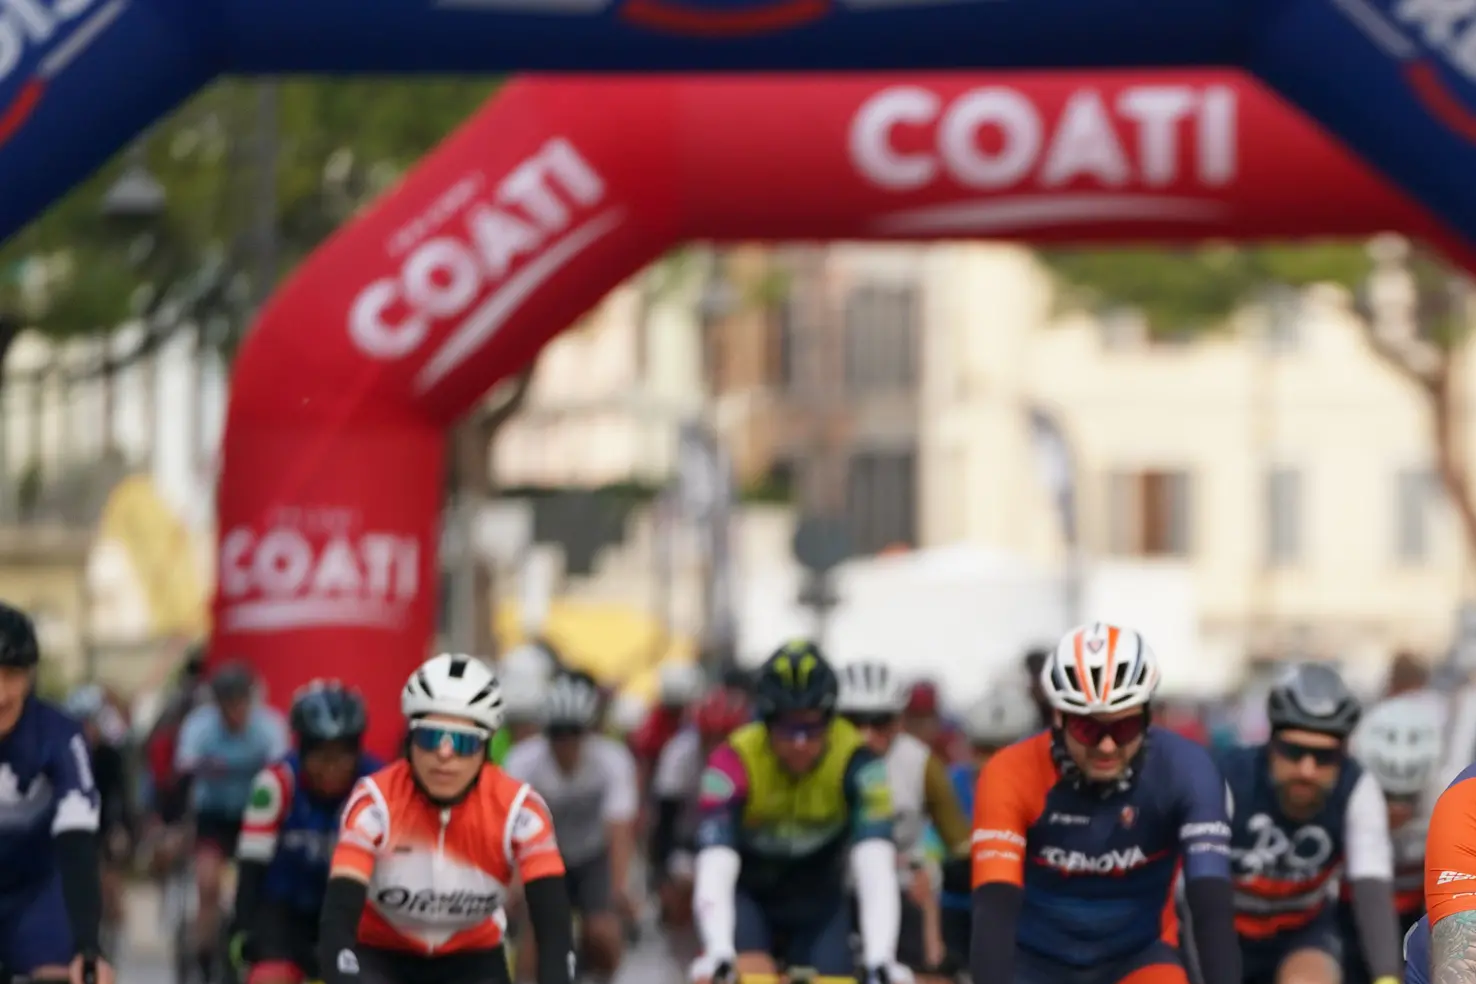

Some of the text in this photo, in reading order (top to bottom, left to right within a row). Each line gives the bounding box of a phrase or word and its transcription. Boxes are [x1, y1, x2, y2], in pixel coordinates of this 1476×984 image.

[849, 86, 1239, 190] COATI
[347, 137, 606, 360] COATI
[222, 528, 418, 598] COATI
